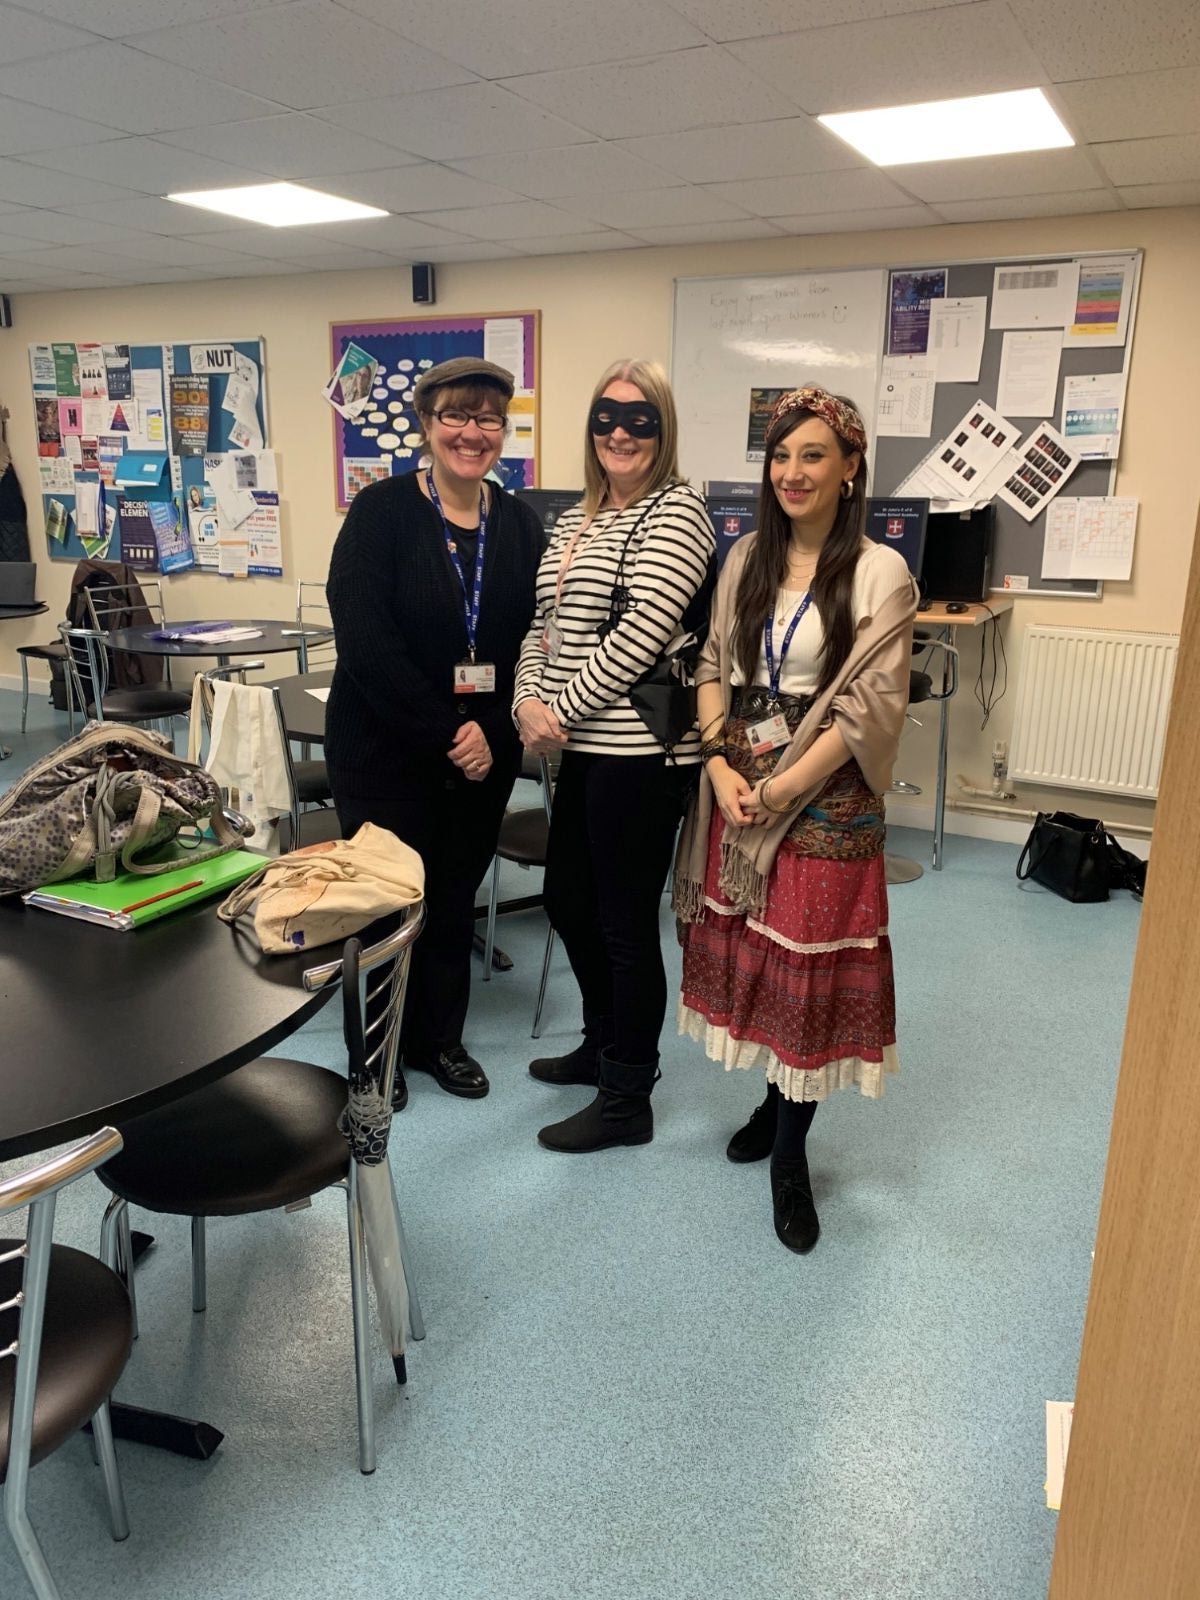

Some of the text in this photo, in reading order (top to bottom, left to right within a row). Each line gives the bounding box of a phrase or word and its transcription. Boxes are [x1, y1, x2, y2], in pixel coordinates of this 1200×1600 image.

[895, 304, 918, 312] ABILITY
[206, 349, 233, 368] NUT
[123, 501, 148, 509] DECISIV
[120, 508, 149, 517] ELEMEN
[795, 601, 808, 618] STAFF
[784, 626, 795, 644] STAFF
